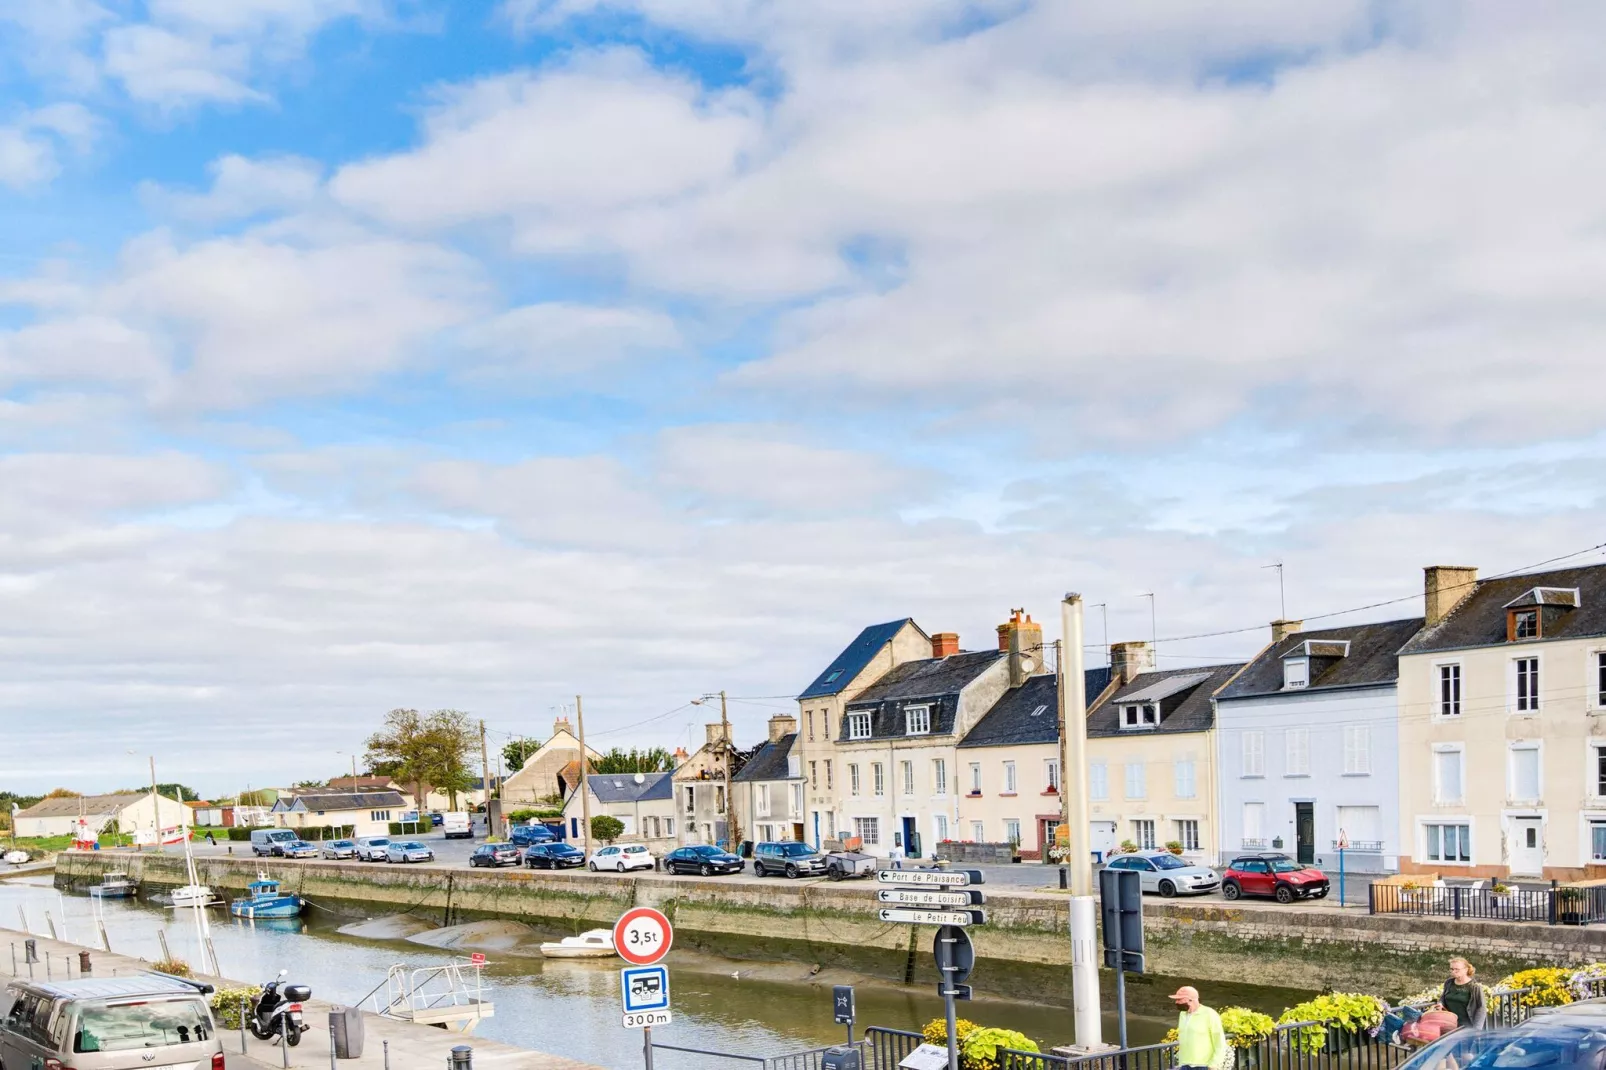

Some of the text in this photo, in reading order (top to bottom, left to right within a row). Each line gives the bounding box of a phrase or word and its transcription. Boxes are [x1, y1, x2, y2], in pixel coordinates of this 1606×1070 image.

[892, 871, 965, 884] Port de Plaisance
[899, 892, 966, 903] Base de Loisirs
[913, 913, 967, 923] Le Petit Feu
